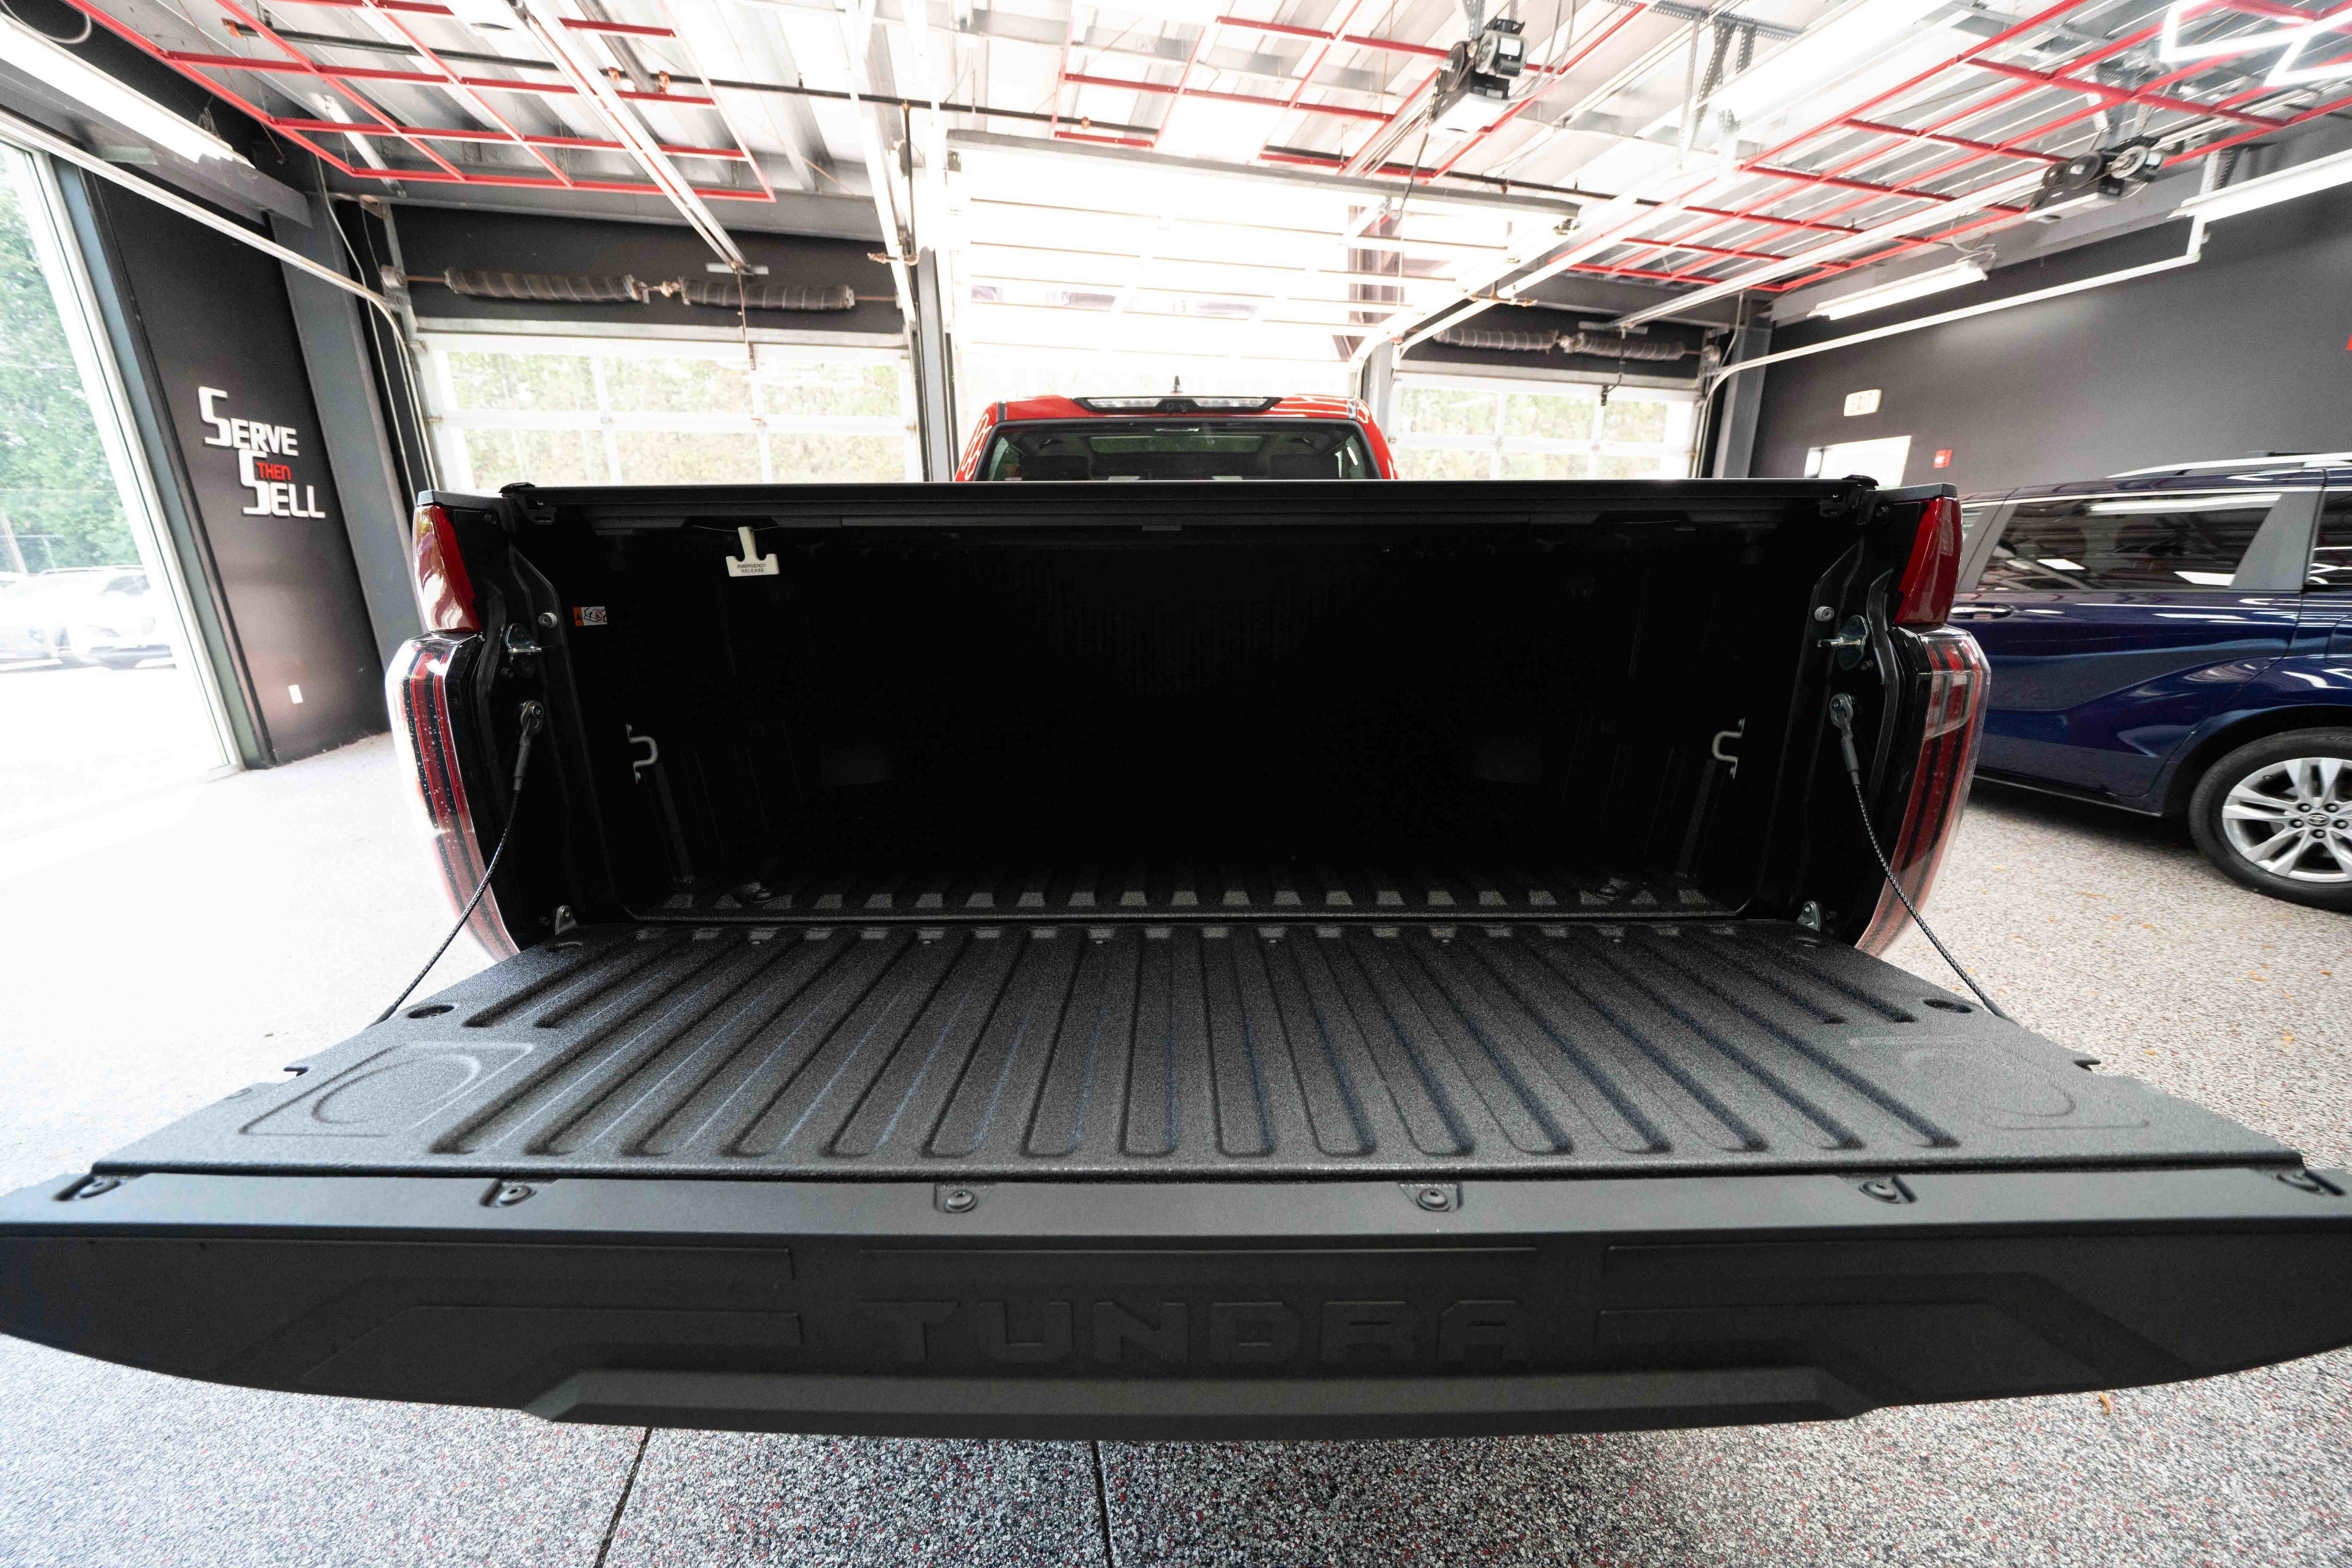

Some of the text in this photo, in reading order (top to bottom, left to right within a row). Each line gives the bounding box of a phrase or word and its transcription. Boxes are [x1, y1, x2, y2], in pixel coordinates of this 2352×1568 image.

[198, 386, 299, 457] SERVE
[238, 449, 326, 519] SELL
[256, 462, 292, 481] THEN
[860, 1300, 1526, 1362] TUNDRA
